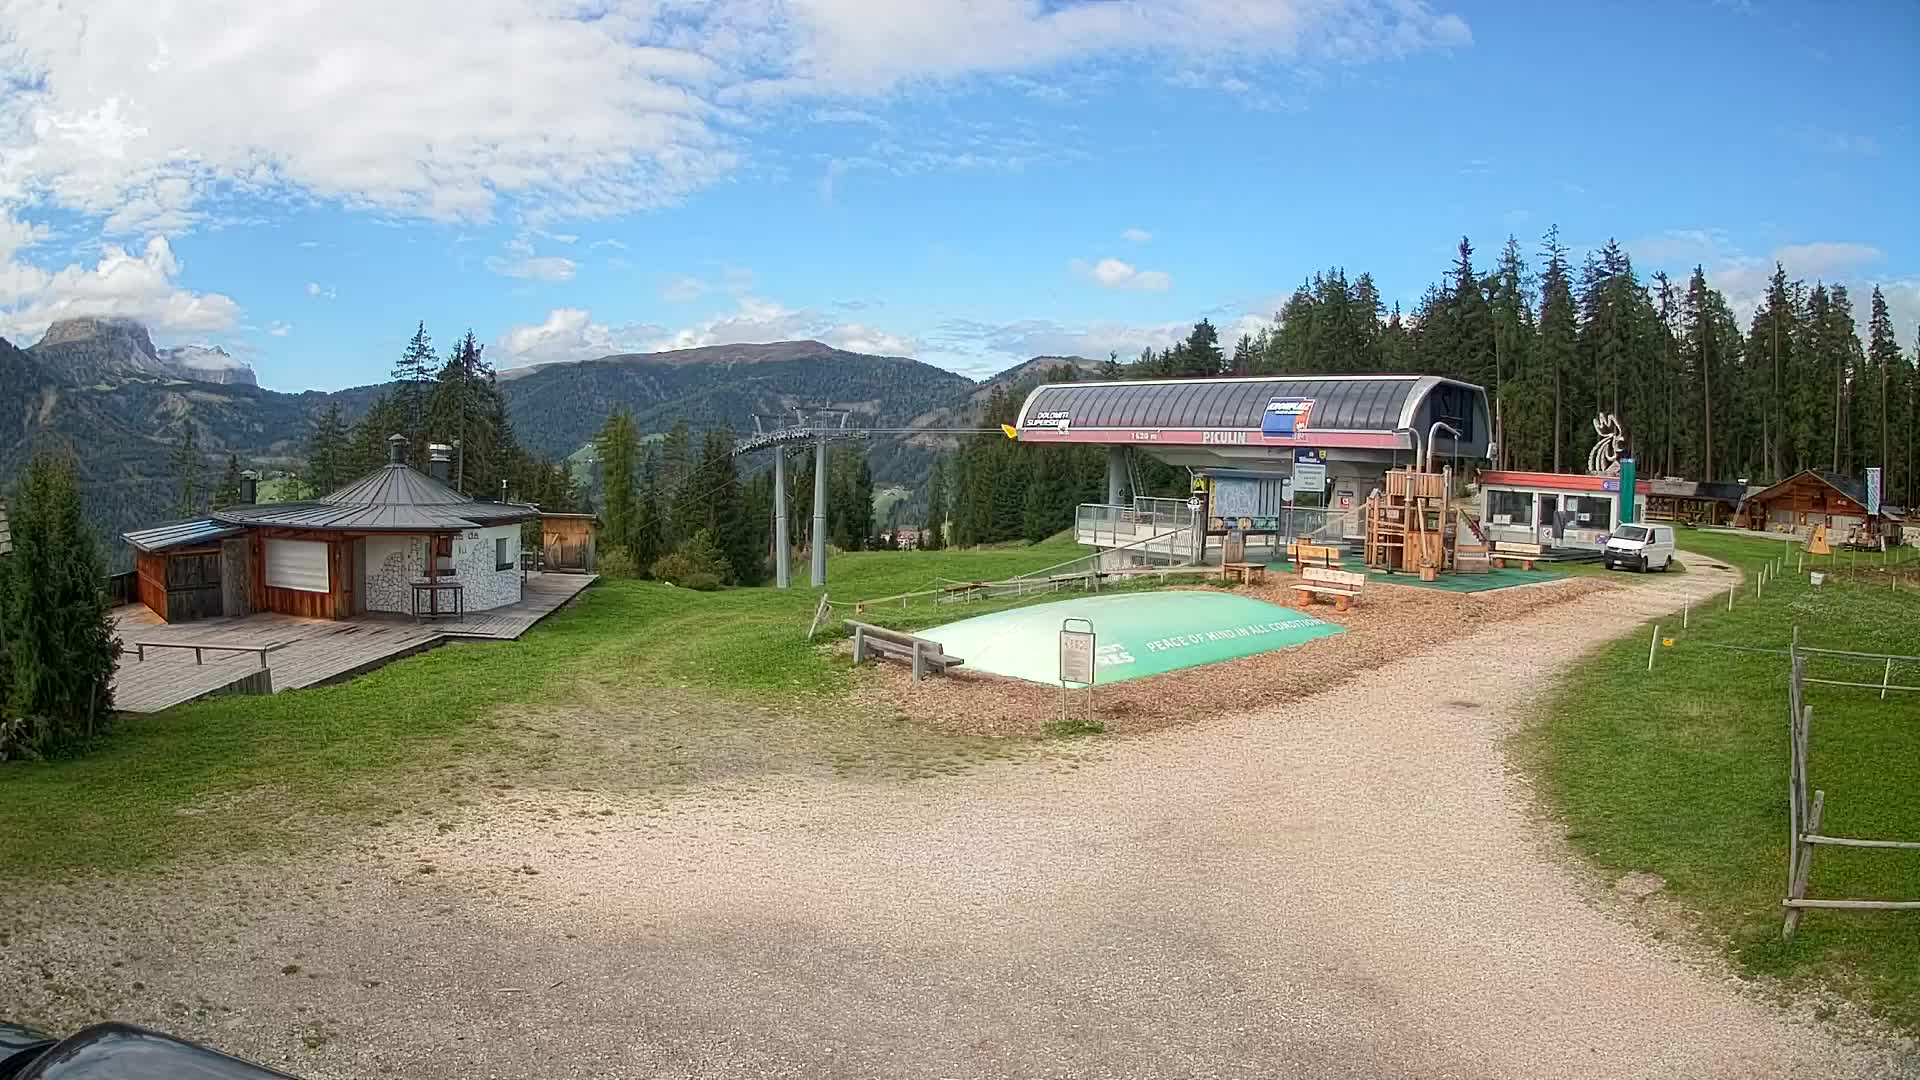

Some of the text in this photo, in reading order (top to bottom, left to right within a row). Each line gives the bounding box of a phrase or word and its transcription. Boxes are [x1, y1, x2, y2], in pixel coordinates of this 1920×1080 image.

[1037, 411, 1069, 419] DOLOMITI
[1203, 431, 1246, 445] PICULIN
[1145, 636, 1190, 653] PEACE
[1187, 633, 1204, 644] OF
[1205, 629, 1236, 641] MIND
[1235, 625, 1250, 637] IN
[1248, 624, 1271, 634] ALL
